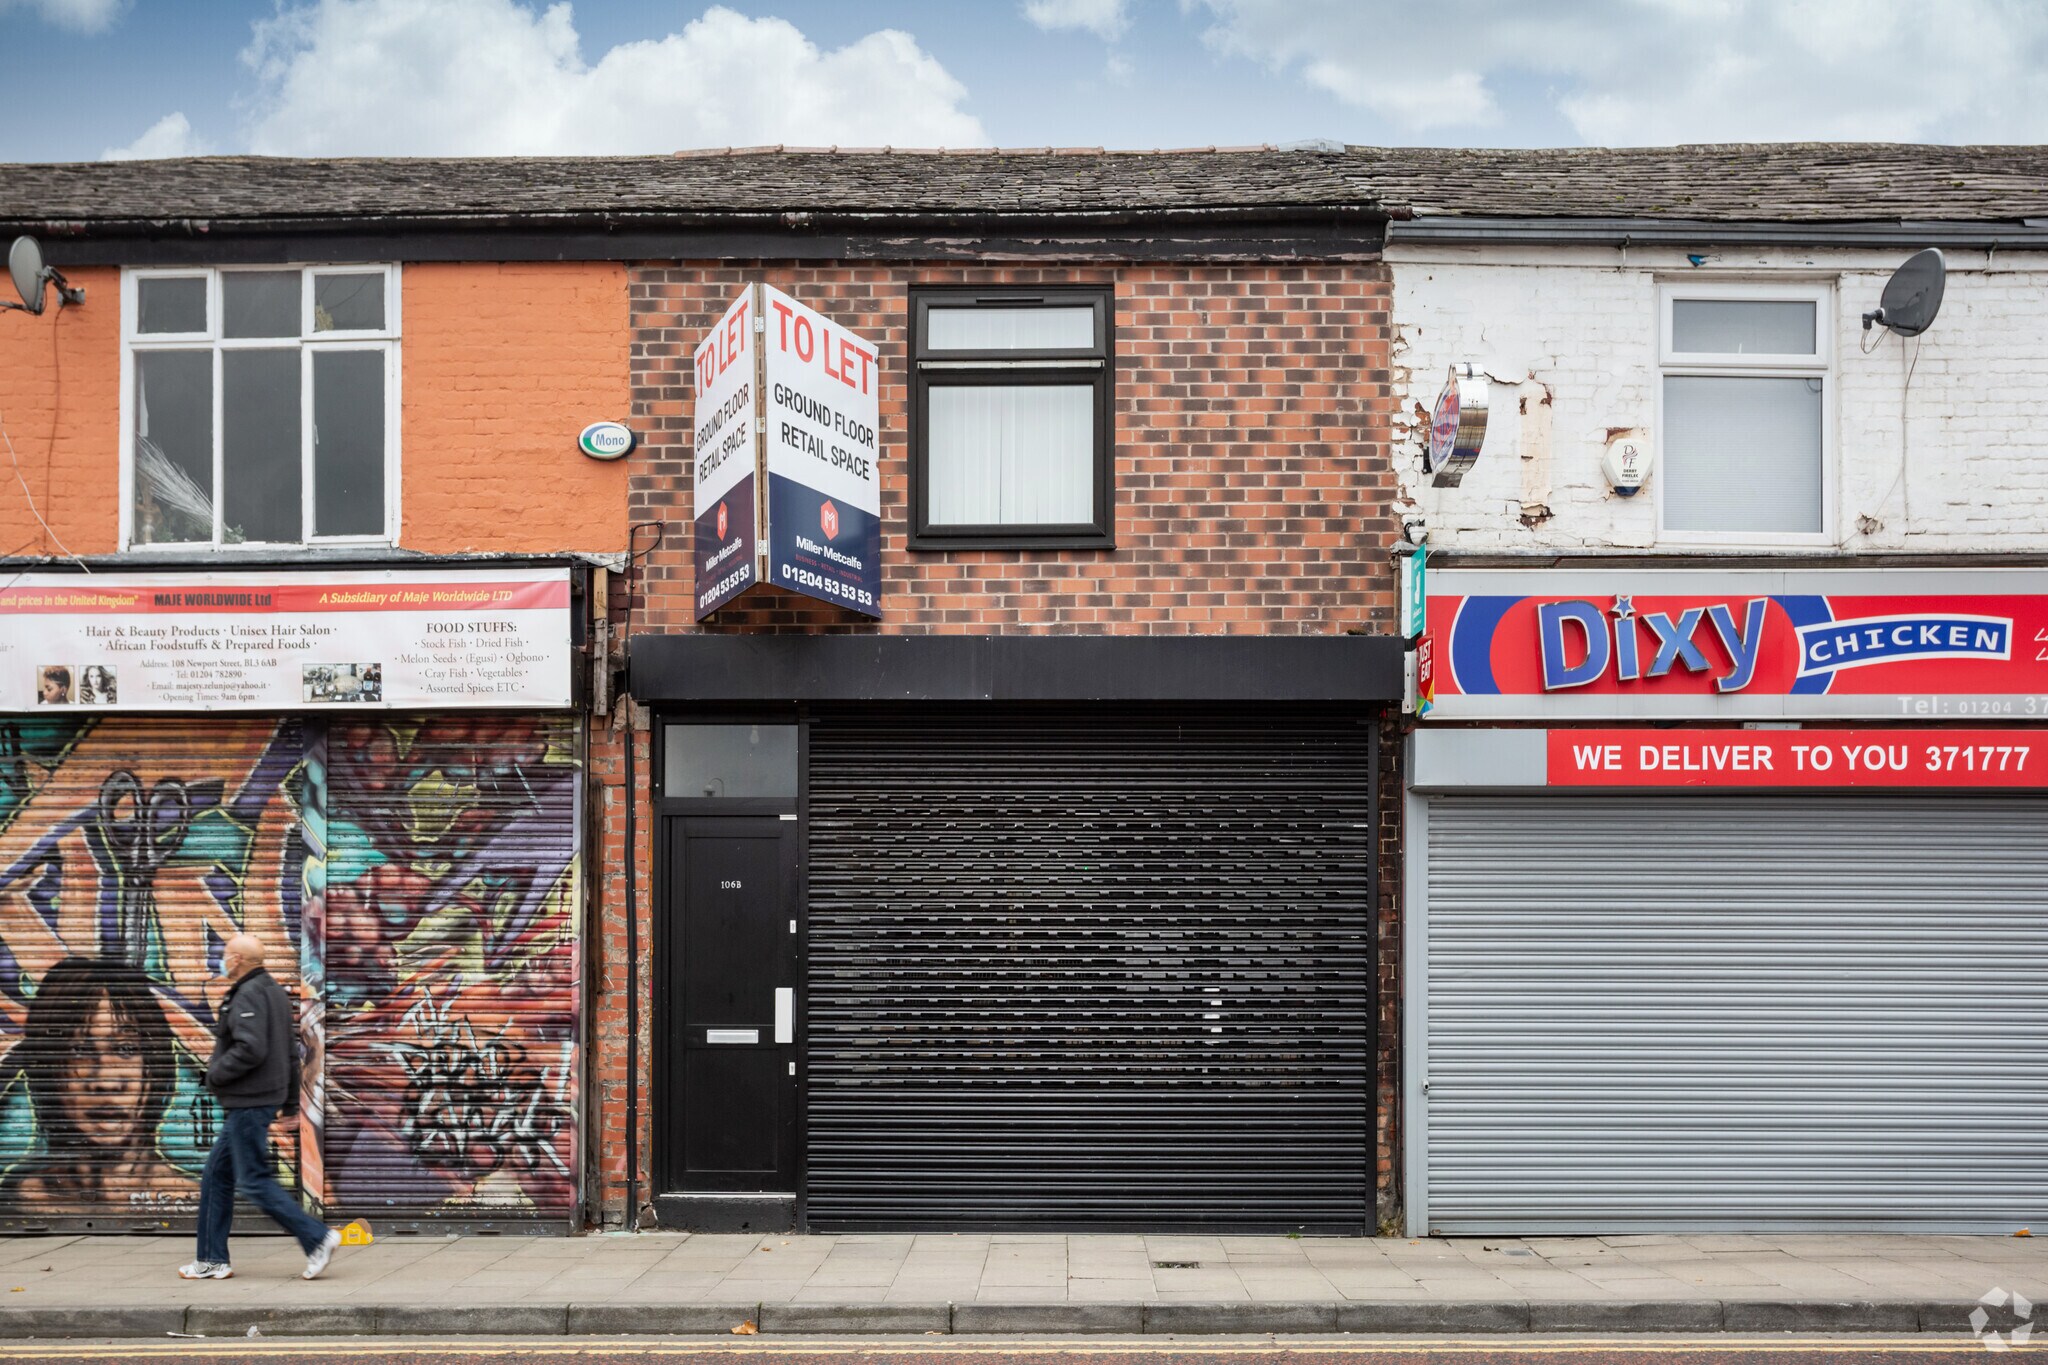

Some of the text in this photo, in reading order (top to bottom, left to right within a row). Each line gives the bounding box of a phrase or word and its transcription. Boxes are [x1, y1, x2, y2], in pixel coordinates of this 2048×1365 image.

[697, 300, 748, 398] TO LET
[773, 300, 873, 395] TO LET
[697, 382, 749, 452] GROUND FLOOR
[774, 382, 874, 450] GROUND FLOOR
[596, 434, 625, 446] Mono
[699, 422, 746, 485] RETAIL SPACE
[781, 421, 870, 481] RETAIL SPACE
[706, 555, 719, 572] Miller
[719, 537, 742, 561] Metcalfe
[796, 535, 862, 570] Miller Metcalfe
[700, 584, 720, 608] 01204
[720, 578, 729, 594] 53
[730, 571, 739, 588] 53
[740, 564, 749, 581] 53
[782, 563, 872, 606] 01204 53 53 53
[18, 595, 42, 608] prices
[44, 595, 52, 606] in
[55, 595, 68, 606] the
[70, 595, 97, 606] United
[154, 593, 272, 606] MAJE WORLDWIDE Ltd
[319, 590, 512, 606] A Subsidiary of Maje Worldwide LTD
[86, 624, 330, 640] Hair & Beauty Products Unisex Hair Salon
[426, 621, 517, 633] FOOD STUFFS:
[106, 637, 311, 653] African Foodstuffs & Prepared Foods
[420, 637, 523, 649] Stock Fish Dried Fish
[1536, 594, 1768, 693] Dixy
[1809, 625, 1999, 662] CHICKEN
[400, 652, 544, 666] Melon Seeds (Egusi) Ogbono
[1418, 639, 1432, 667] JUST
[140, 660, 168, 668] Address:
[171, 660, 185, 668] 108
[187, 659, 218, 670] Newport
[244, 659, 259, 667] BL3
[261, 658, 277, 667] 6AB
[1421, 659, 1432, 683] EAT
[176, 670, 242, 678] Tel: 01204 782890
[425, 666, 523, 681] Cray Fish Vegetables
[163, 693, 255, 702] Opening Times: 9am 6pm
[426, 682, 519, 696] Assorted Spices ETC
[1897, 697, 1948, 714] Tel:
[1959, 701, 2012, 714] 01204
[1573, 745, 2030, 771] WE DELIVER TO YOU 371777
[720, 881, 742, 889] 106B
